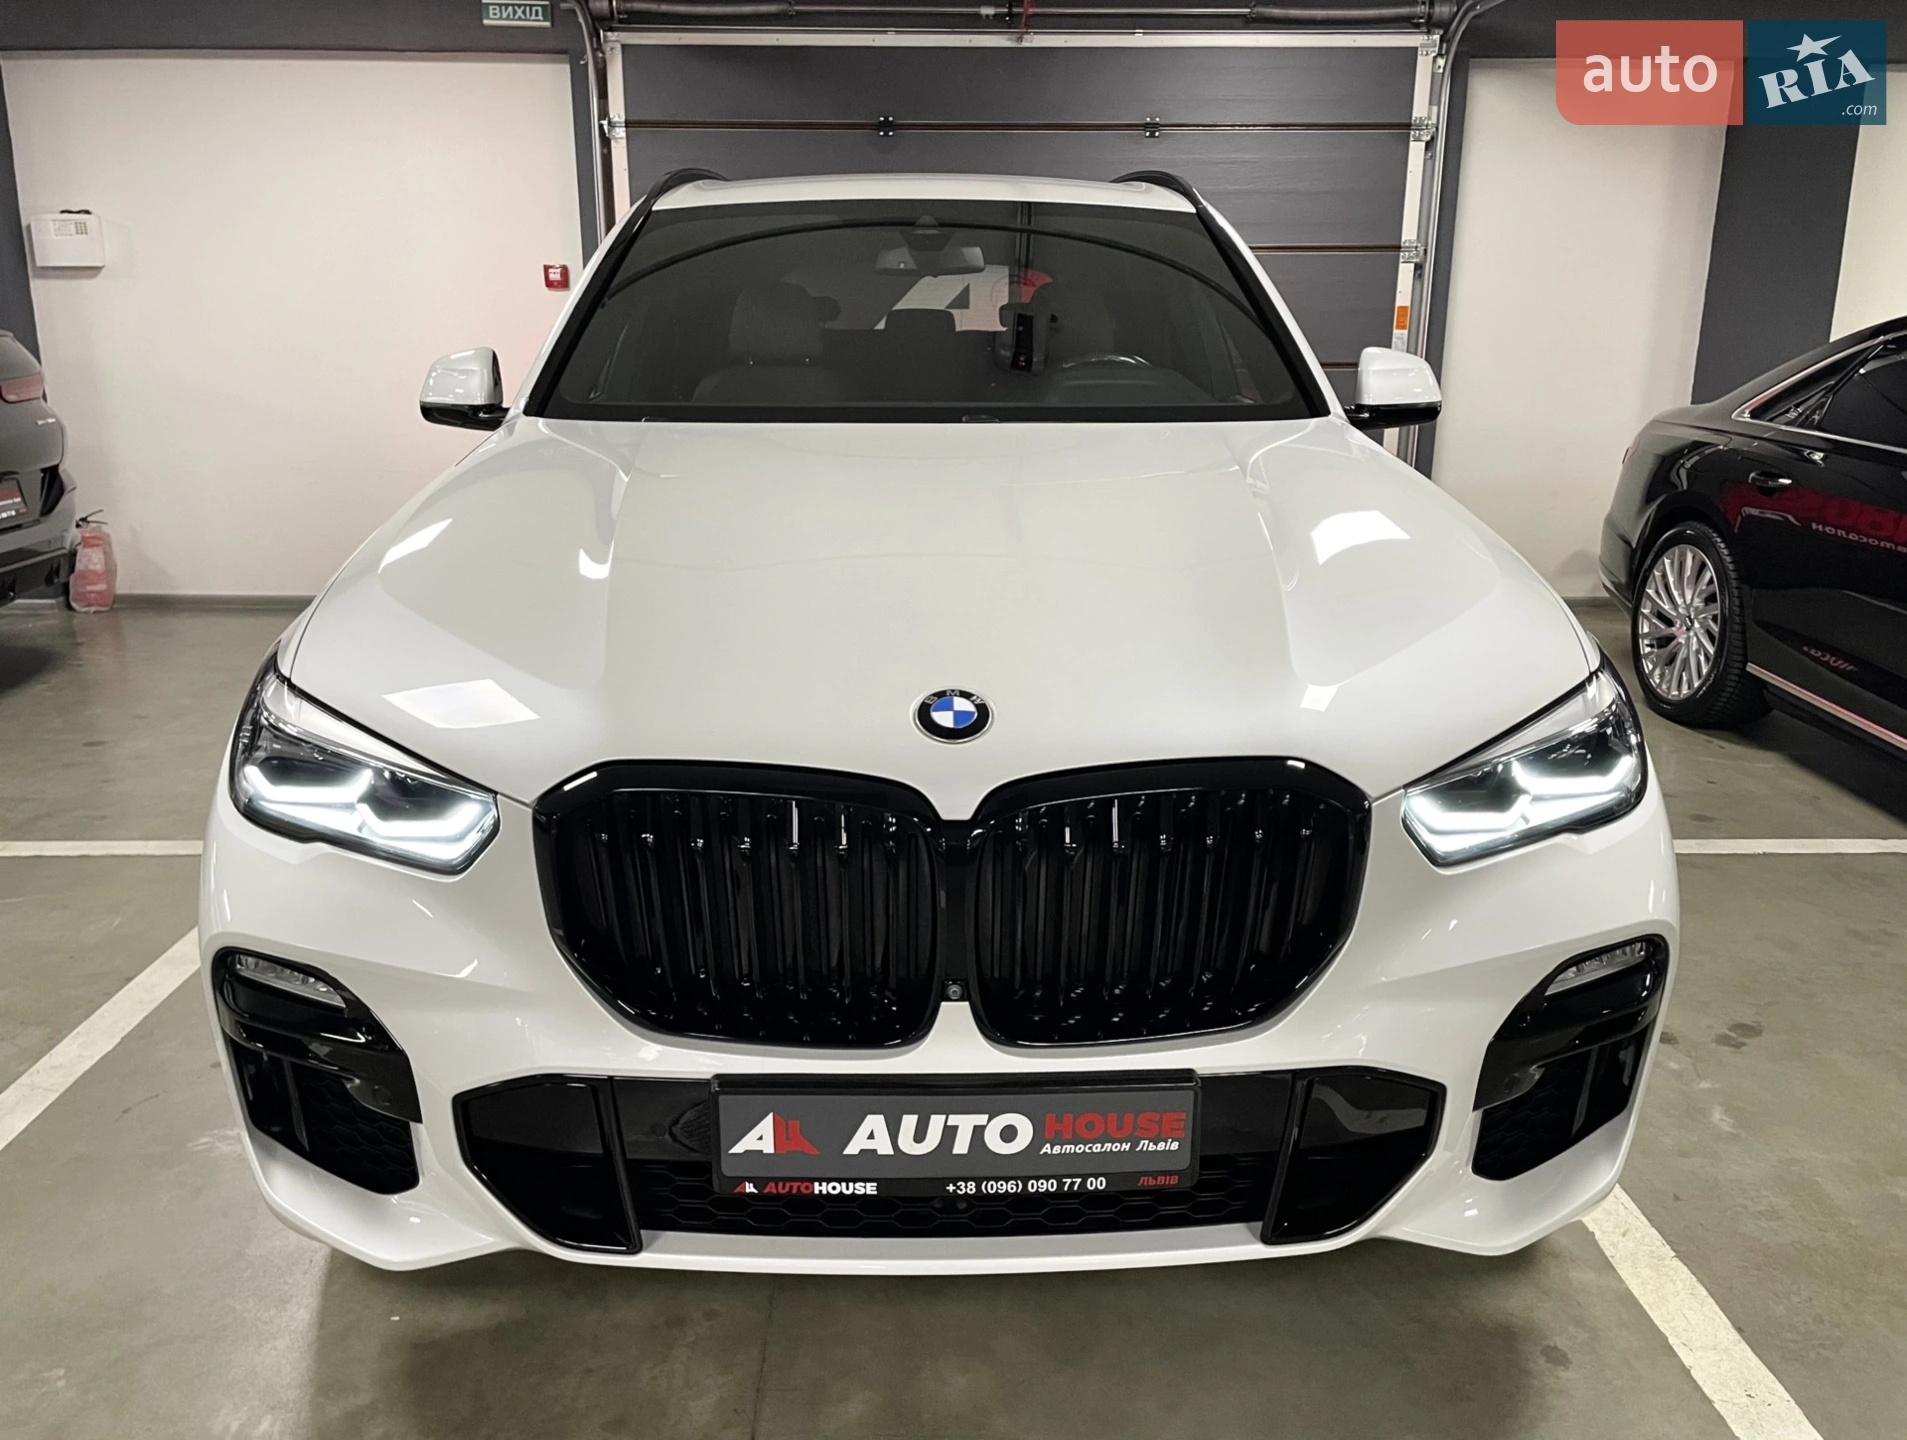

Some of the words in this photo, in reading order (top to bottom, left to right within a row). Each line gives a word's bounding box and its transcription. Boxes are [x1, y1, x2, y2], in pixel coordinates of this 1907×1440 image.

[488, 5, 544, 20] ВИХІД
[923, 689, 985, 705] BMW
[842, 1110, 1034, 1155] AUTO
[1044, 1111, 1187, 1140] HOUSE
[1039, 1140, 1131, 1155] Автосалон
[1135, 1138, 1180, 1152] Львів
[763, 1181, 878, 1195] AUTOHOUSE
[945, 1181, 976, 1195] +38
[981, 1179, 1023, 1194] (096)
[1027, 1178, 1058, 1192] 090
[1062, 1177, 1082, 1191] 77
[1086, 1176, 1107, 1190] 00
[1136, 1175, 1179, 1187] ЛЬВІВ
